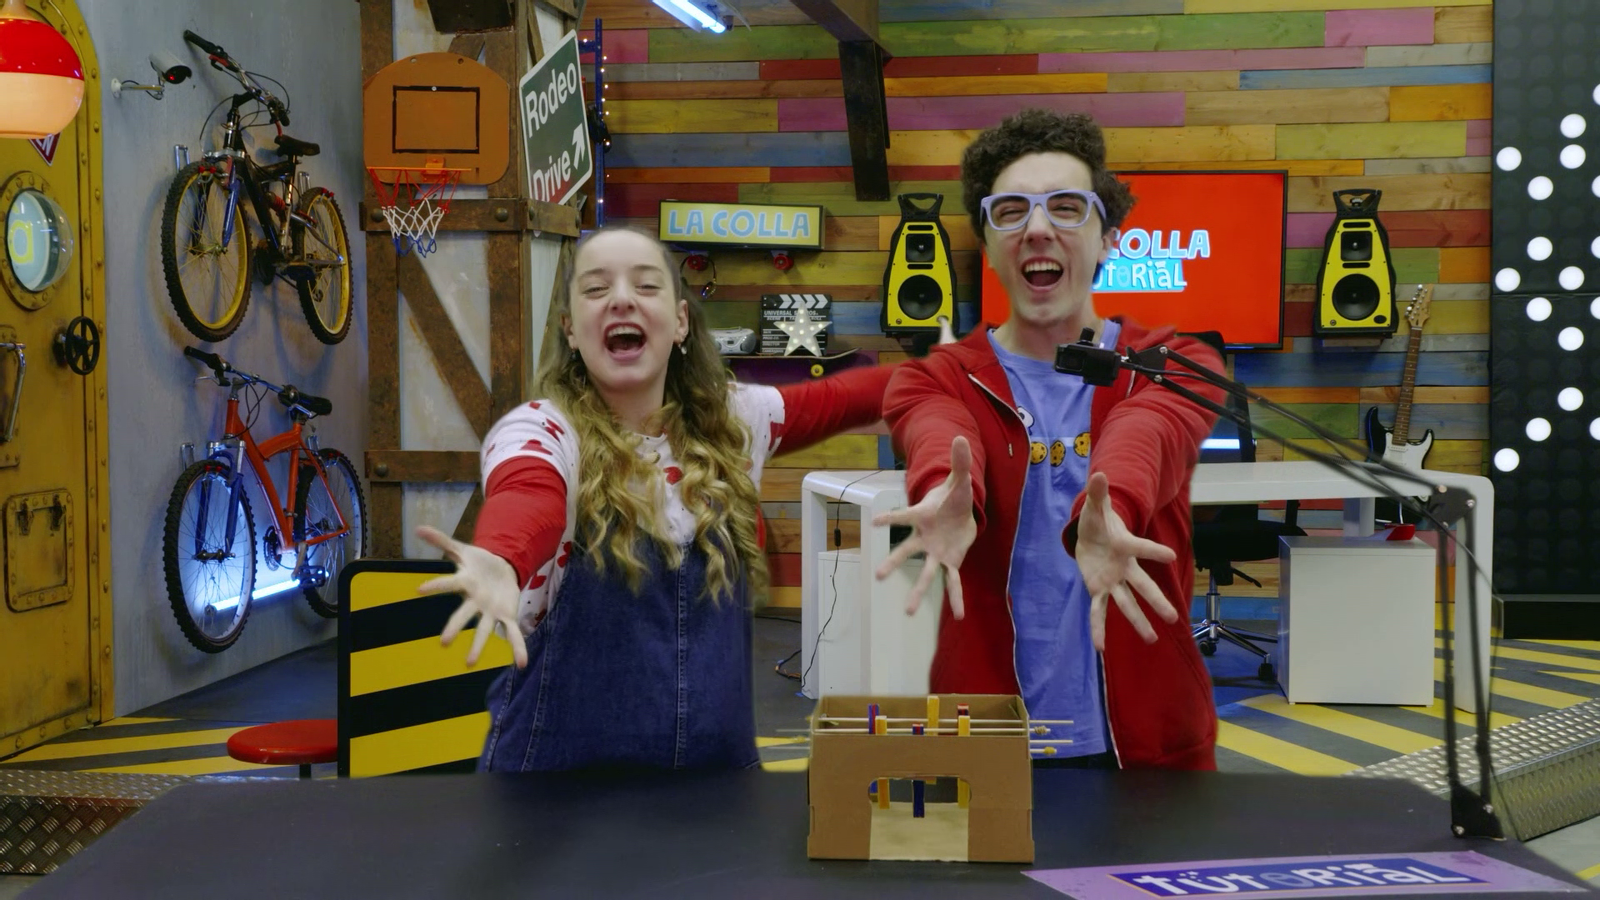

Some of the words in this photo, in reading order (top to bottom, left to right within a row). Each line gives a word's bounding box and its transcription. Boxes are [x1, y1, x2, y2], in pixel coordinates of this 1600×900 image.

[525, 62, 577, 138] Rodeo
[533, 150, 572, 202] Drive
[668, 209, 704, 236] LA
[711, 209, 811, 238] COLLA
